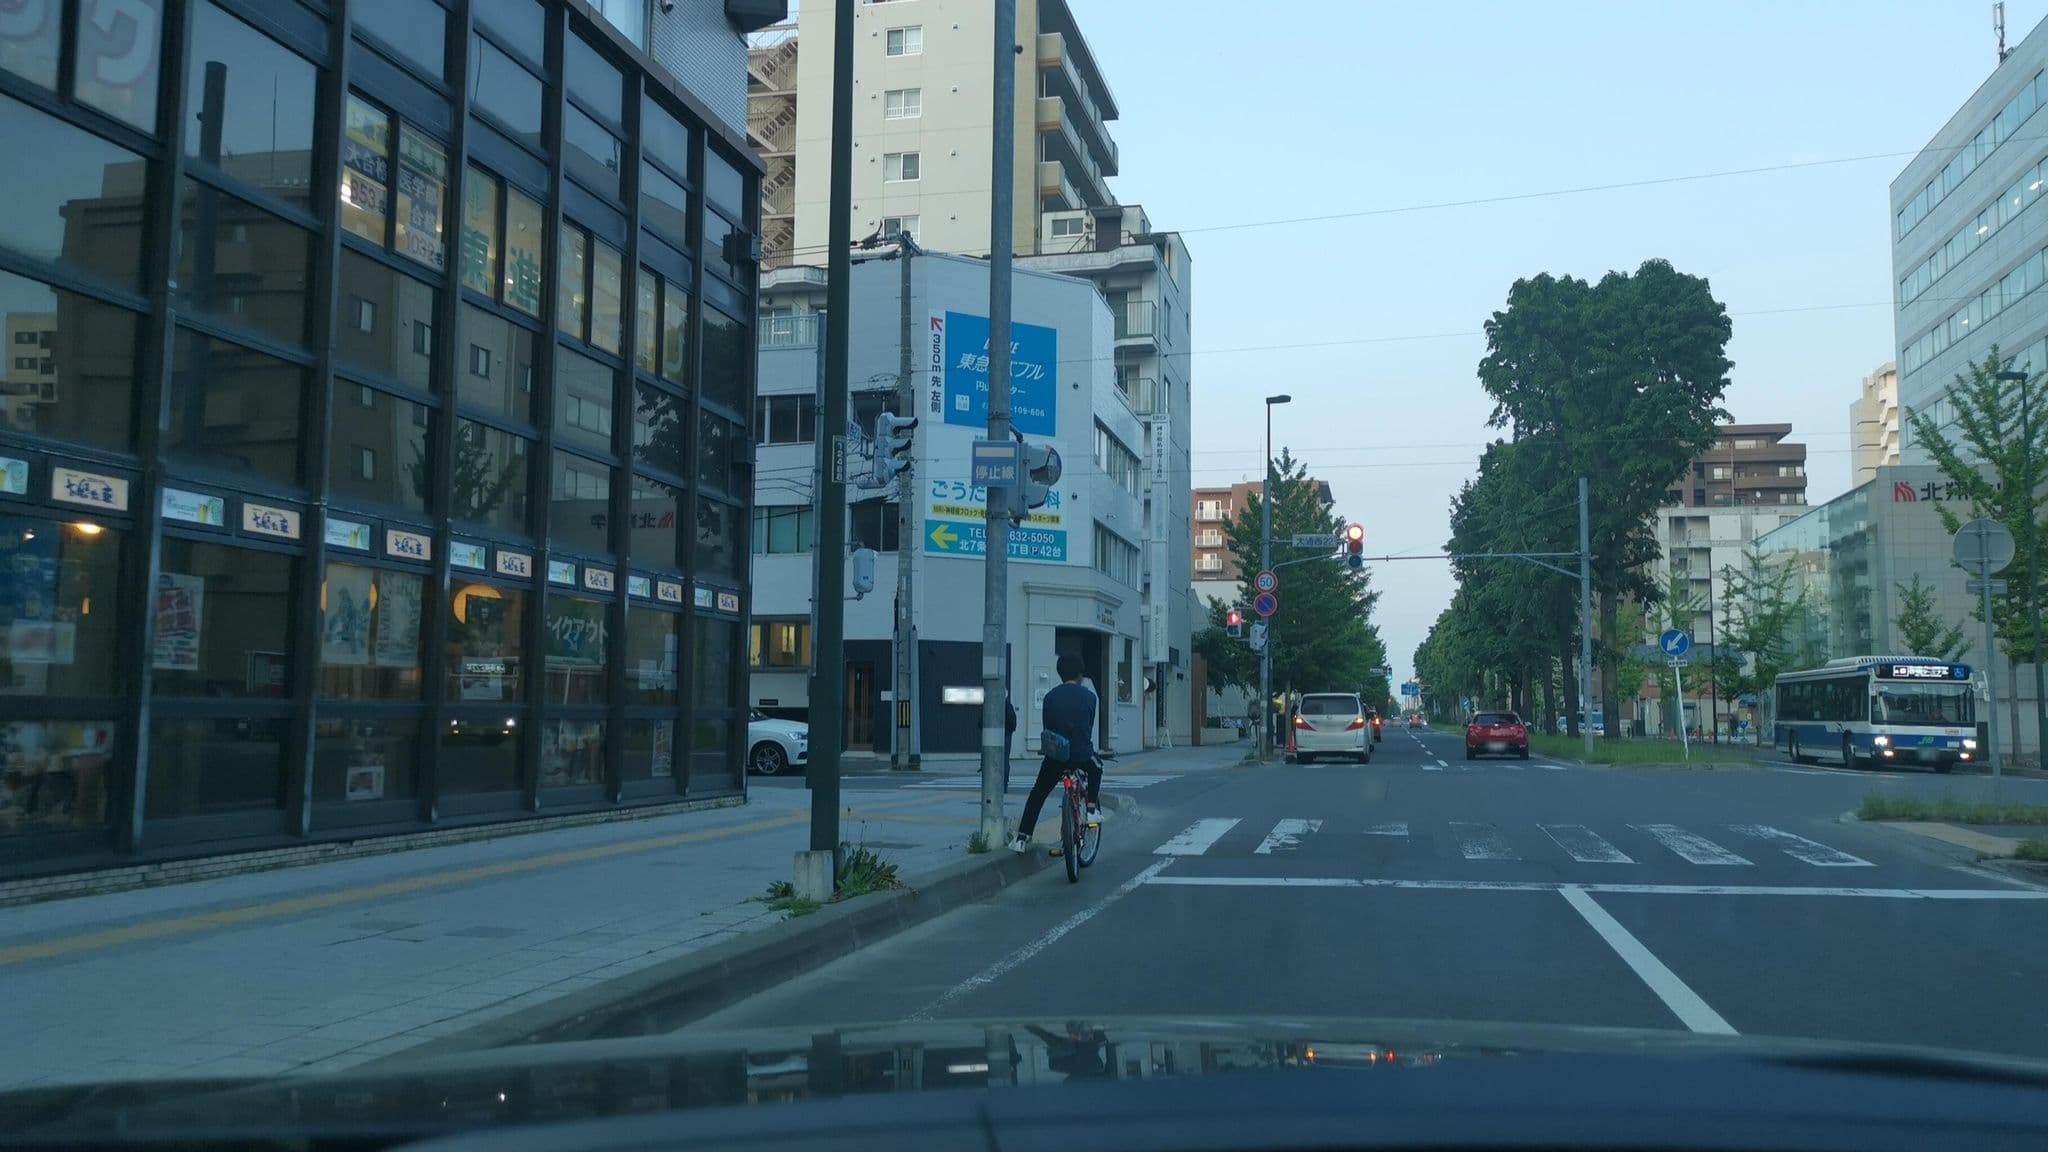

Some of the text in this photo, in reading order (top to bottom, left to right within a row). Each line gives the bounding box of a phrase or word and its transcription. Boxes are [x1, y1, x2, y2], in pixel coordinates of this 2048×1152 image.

[931, 333, 942, 413] 350m先左側
[975, 465, 1015, 480] 停止線
[1259, 575, 1273, 588] 50
